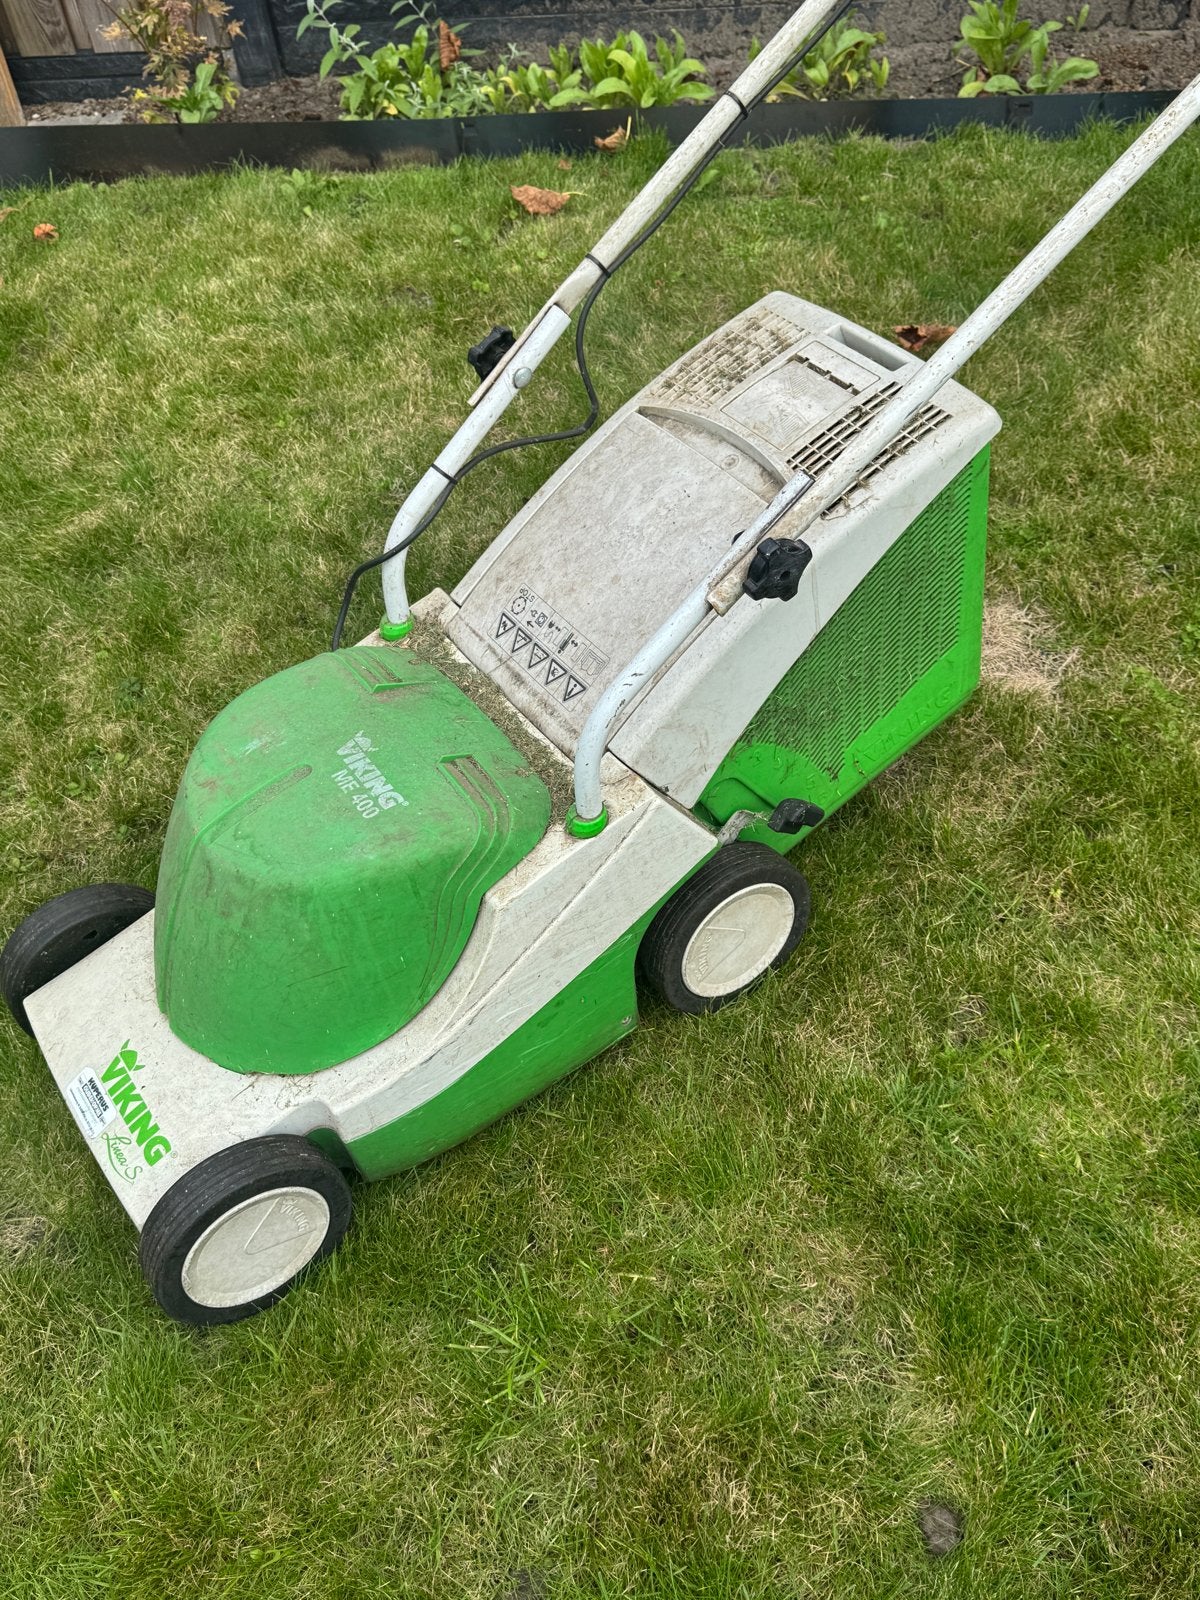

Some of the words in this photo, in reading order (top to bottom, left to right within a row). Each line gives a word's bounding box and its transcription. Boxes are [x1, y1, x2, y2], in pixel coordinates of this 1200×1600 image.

[520, 588, 535, 603] STOP
[331, 769, 360, 794] ME
[352, 794, 380, 818] 400
[337, 738, 405, 810] VIKING
[87, 1077, 109, 1112] KUPERUS
[101, 1055, 172, 1167] VIKING
[101, 1130, 134, 1185] Linea
[124, 1165, 143, 1180] S
[280, 1204, 310, 1232] VIKING
